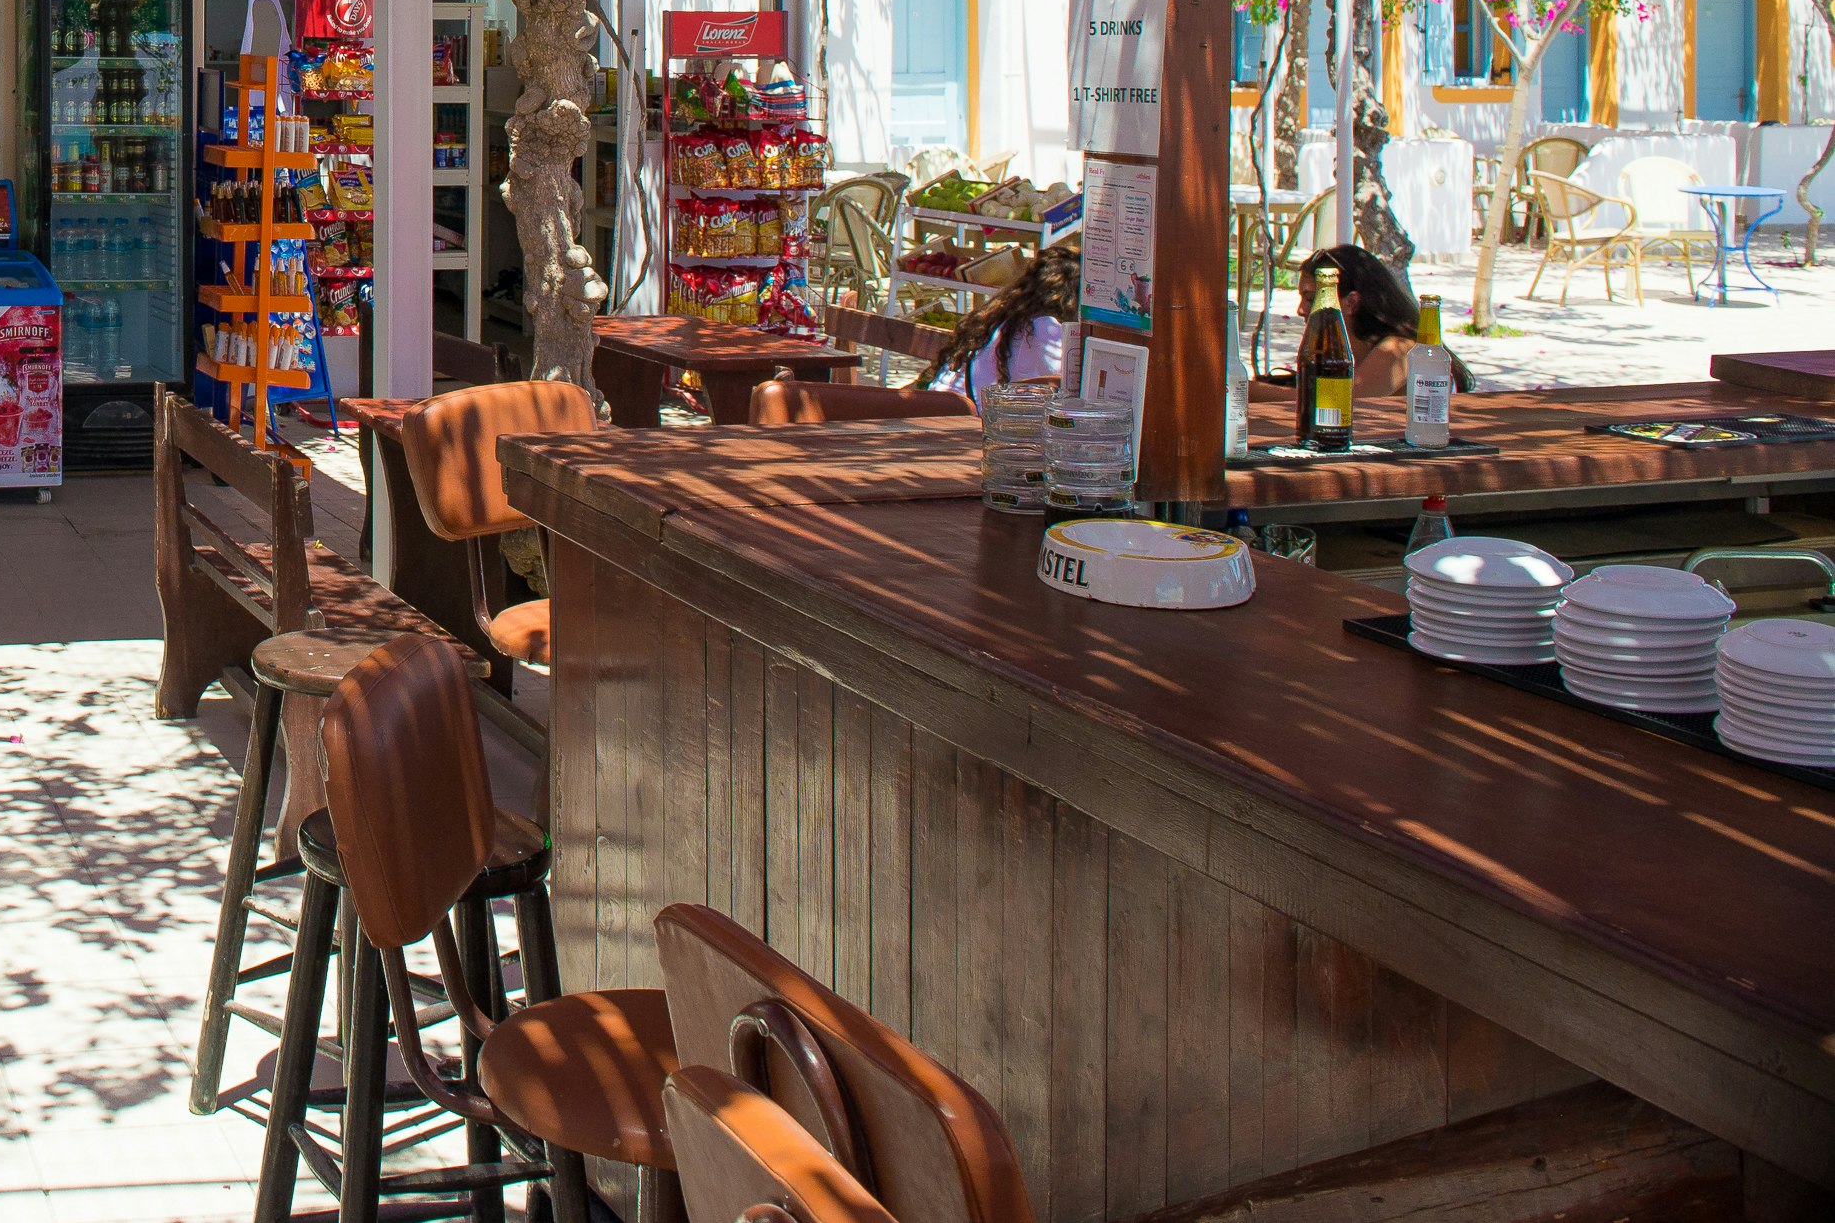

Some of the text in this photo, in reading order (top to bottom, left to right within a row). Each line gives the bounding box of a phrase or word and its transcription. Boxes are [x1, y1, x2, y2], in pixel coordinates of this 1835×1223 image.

[350, 0, 363, 21] DAYS
[702, 24, 748, 41] Lorenz
[1089, 20, 1143, 36] 5 DRINKS
[1073, 87, 1157, 104] 1 T-SHIRT FREE
[0, 325, 50, 339] SMIRNOFF
